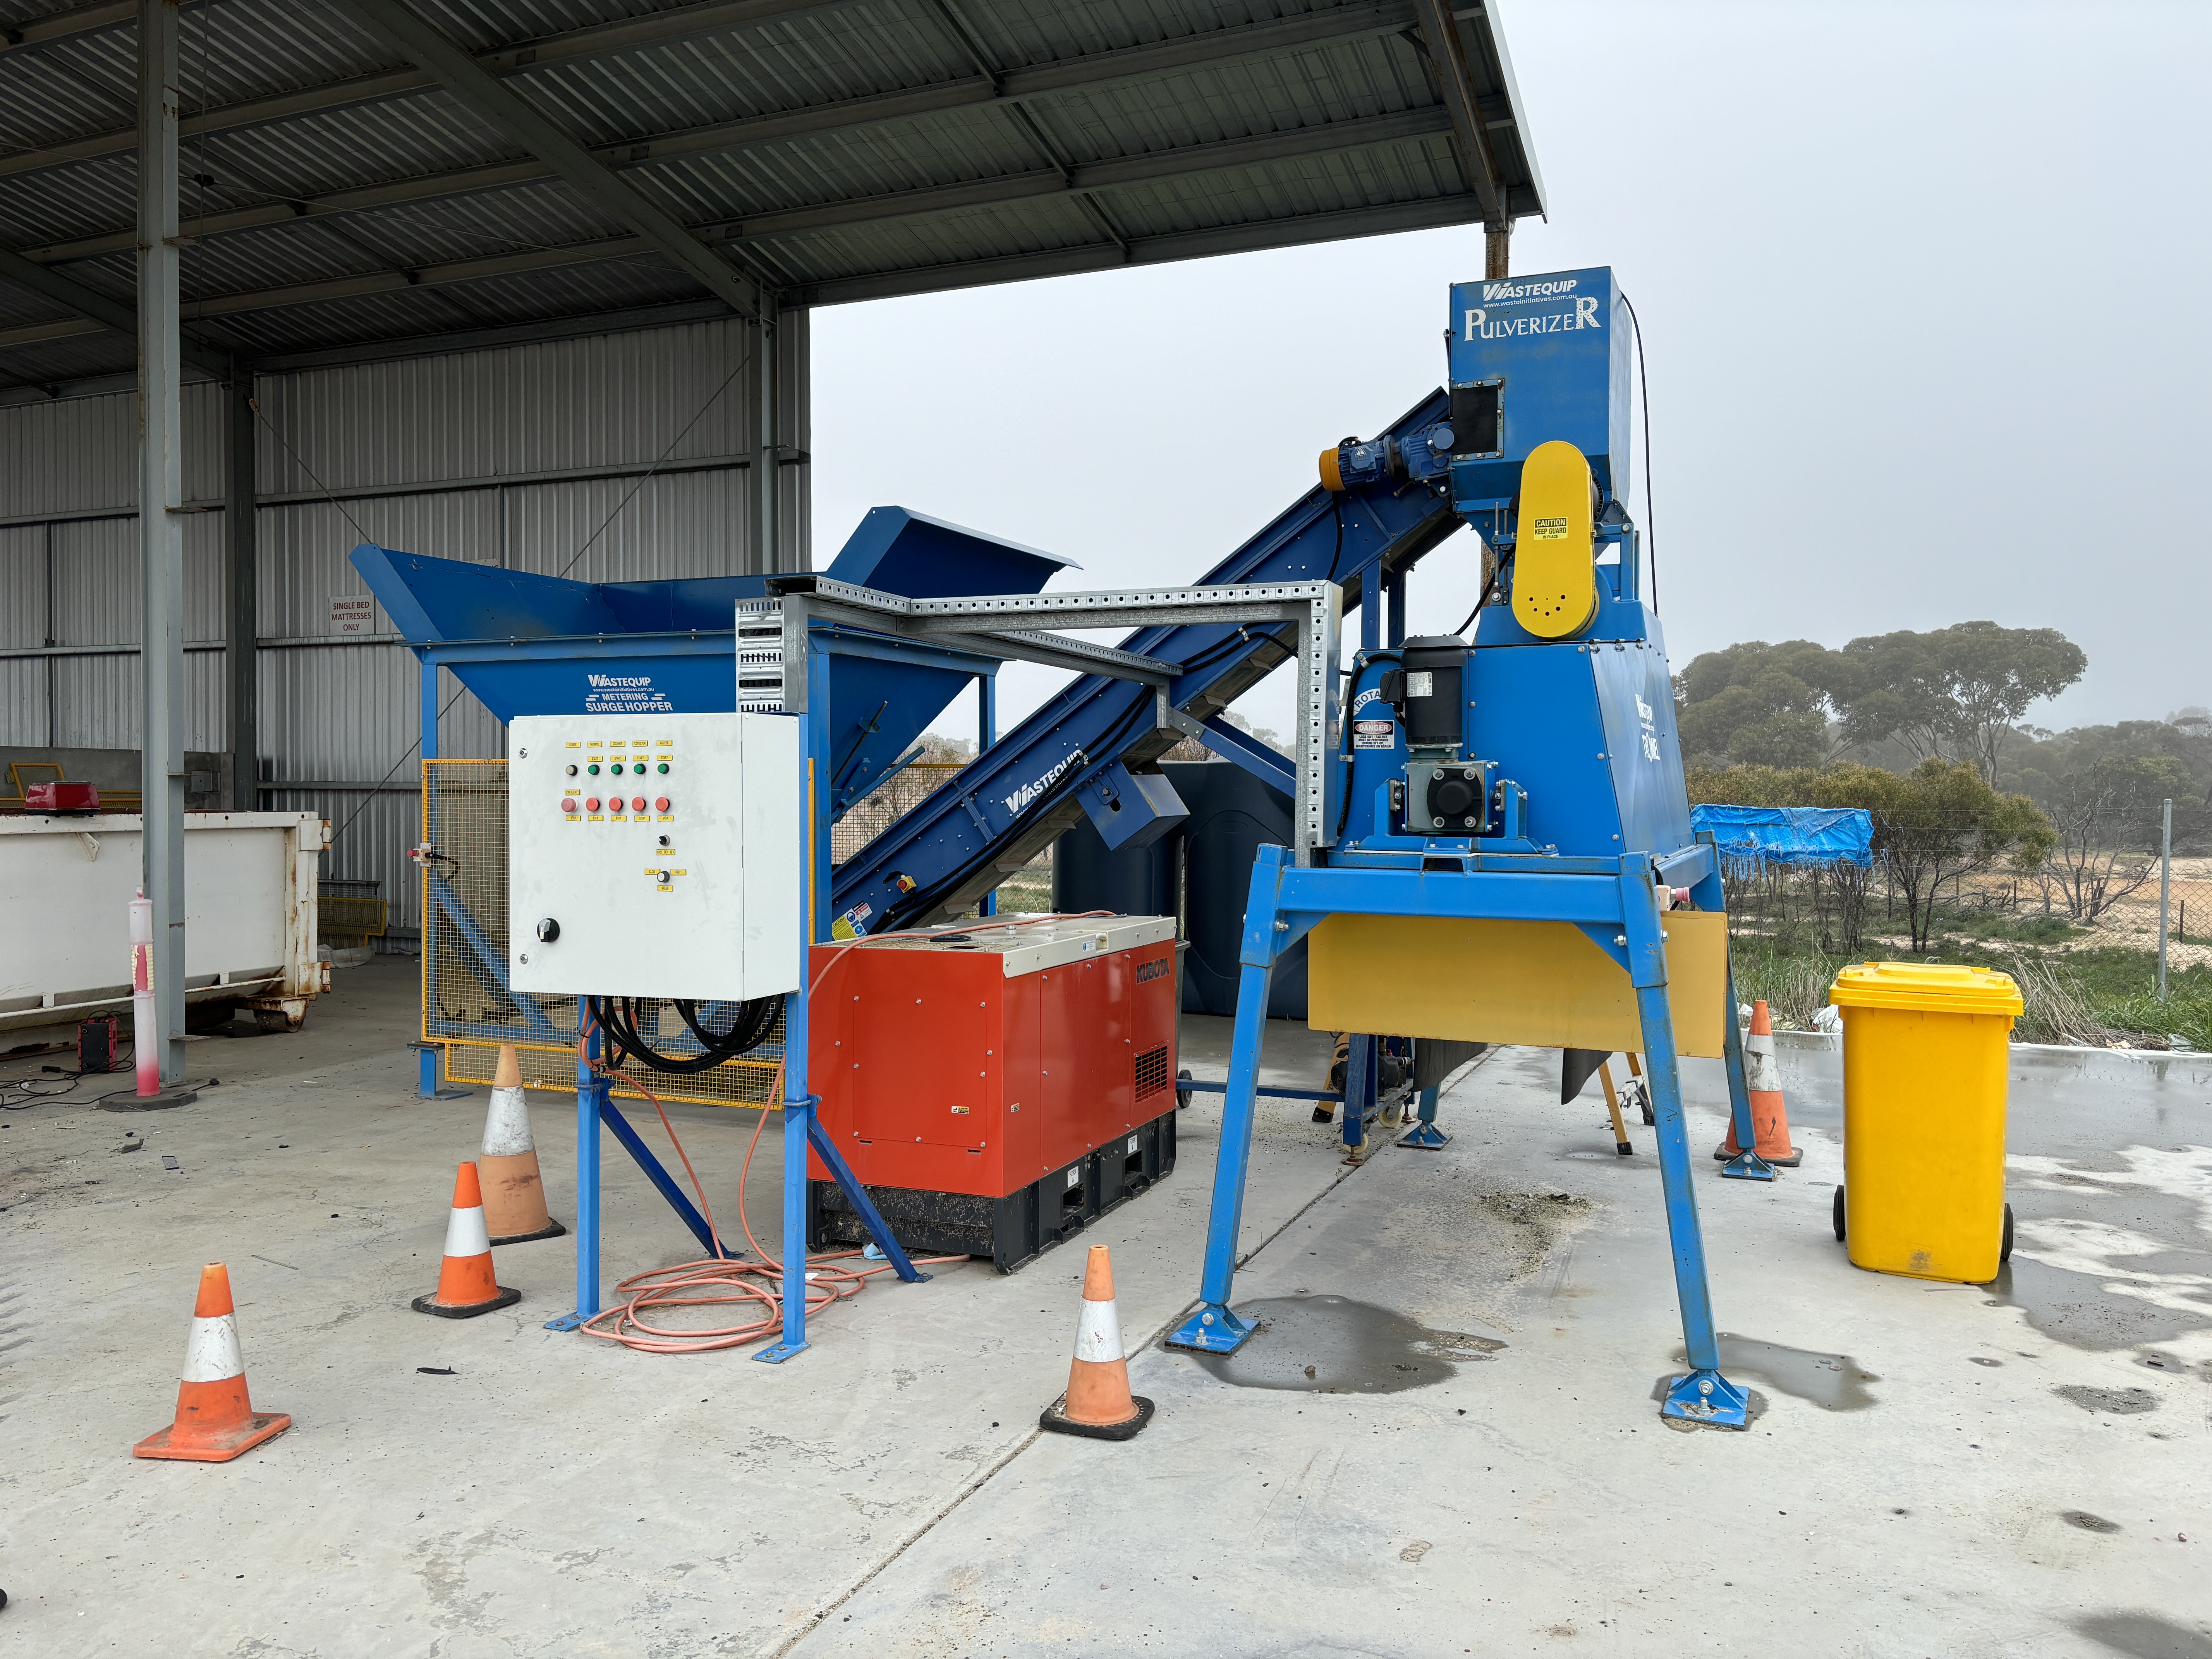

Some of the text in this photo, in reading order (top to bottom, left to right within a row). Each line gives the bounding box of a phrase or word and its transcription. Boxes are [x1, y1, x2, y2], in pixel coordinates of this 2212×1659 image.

[1483, 280, 1577, 301] WASTEQUIP
[1484, 294, 1577, 308] www.wasteinitiatives.com.au
[332, 612, 371, 620] MATTRESSES
[587, 675, 651, 687] WASTEQUIP
[601, 693, 648, 701] METERING
[586, 702, 673, 712] SURGE HOPPER
[1137, 958, 1169, 984] KUBOTA
